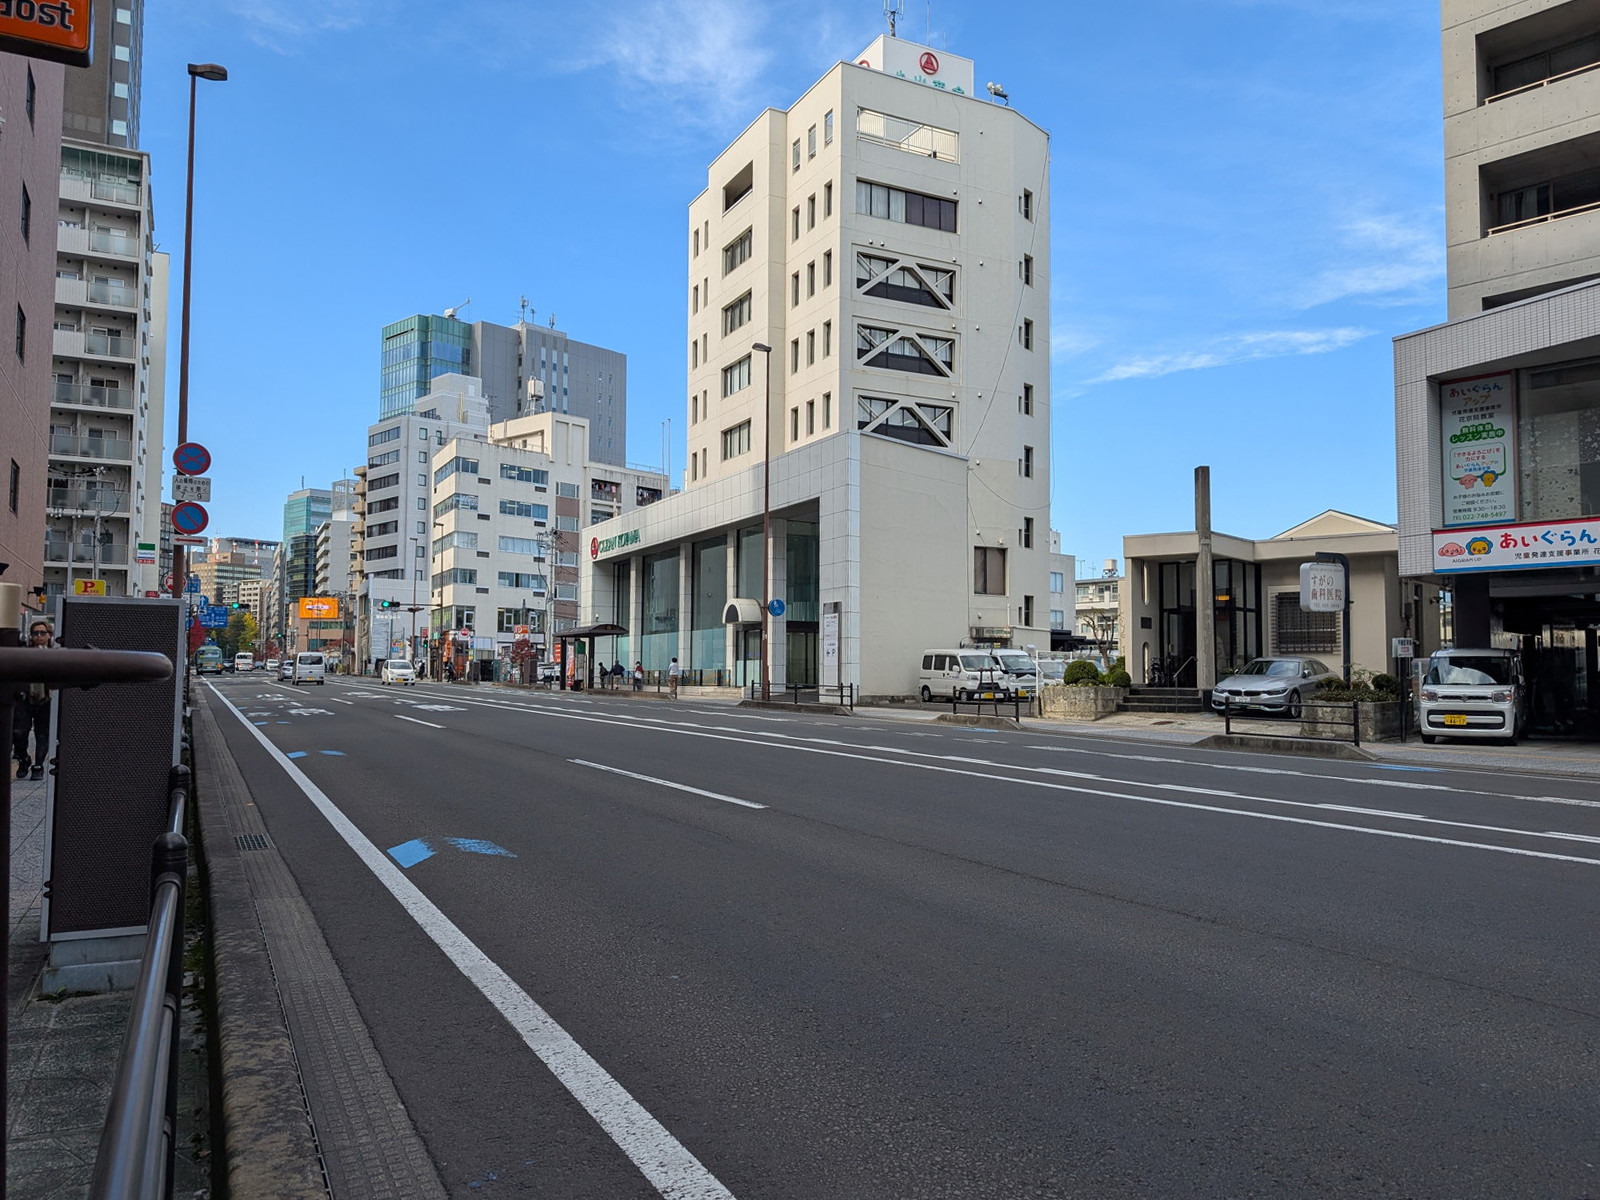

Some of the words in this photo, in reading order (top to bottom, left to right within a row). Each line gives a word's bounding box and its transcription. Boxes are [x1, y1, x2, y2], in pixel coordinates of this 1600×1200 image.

[1449, 382, 1503, 398] あいぐらん
[1499, 529, 1598, 550] あいぐらん
[1514, 549, 1590, 560] 児童発達支援事業所
[82, 581, 95, 593] P
[1311, 574, 1334, 587] すがの
[1311, 588, 1342, 601] 歯科医院
